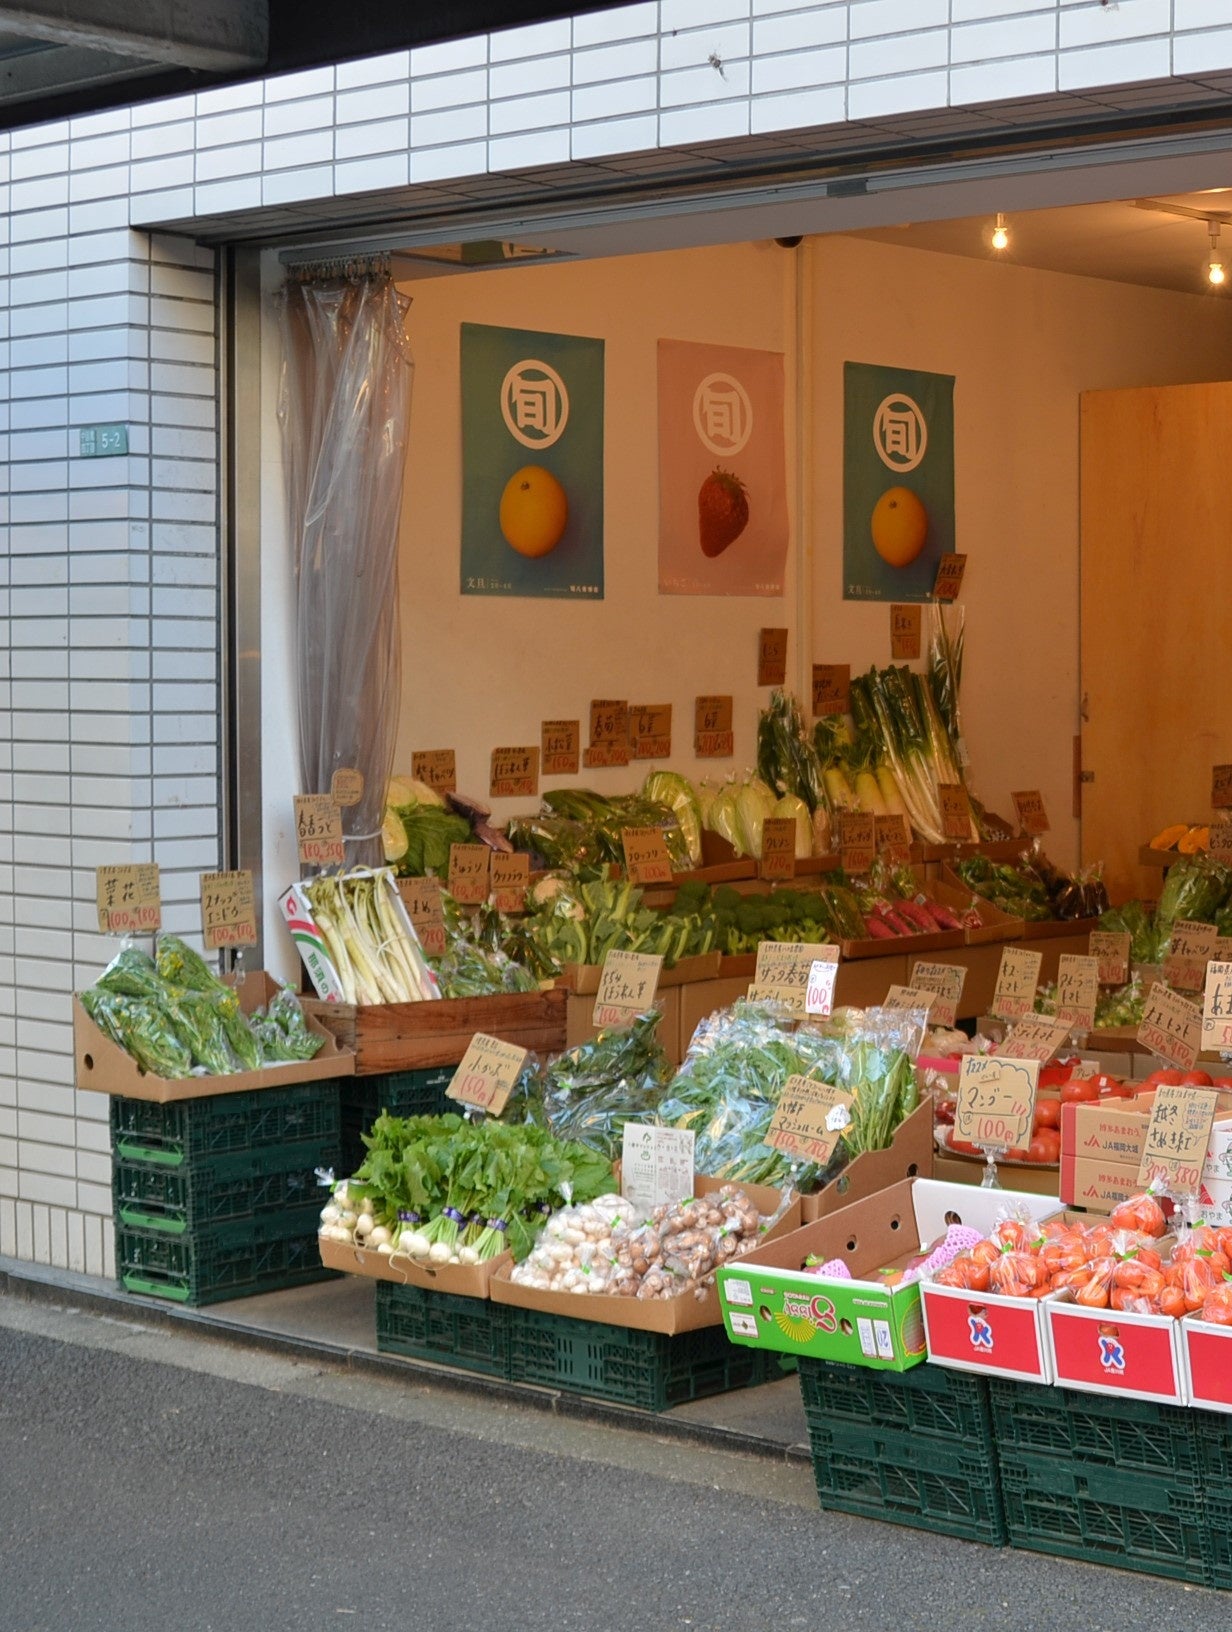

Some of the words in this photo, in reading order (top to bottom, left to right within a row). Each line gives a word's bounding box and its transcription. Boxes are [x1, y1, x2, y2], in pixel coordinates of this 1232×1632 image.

[101, 432, 120, 449] 5-2
[602, 981, 648, 1003] ほうれん草
[467, 1055, 511, 1077] 小かぶ
